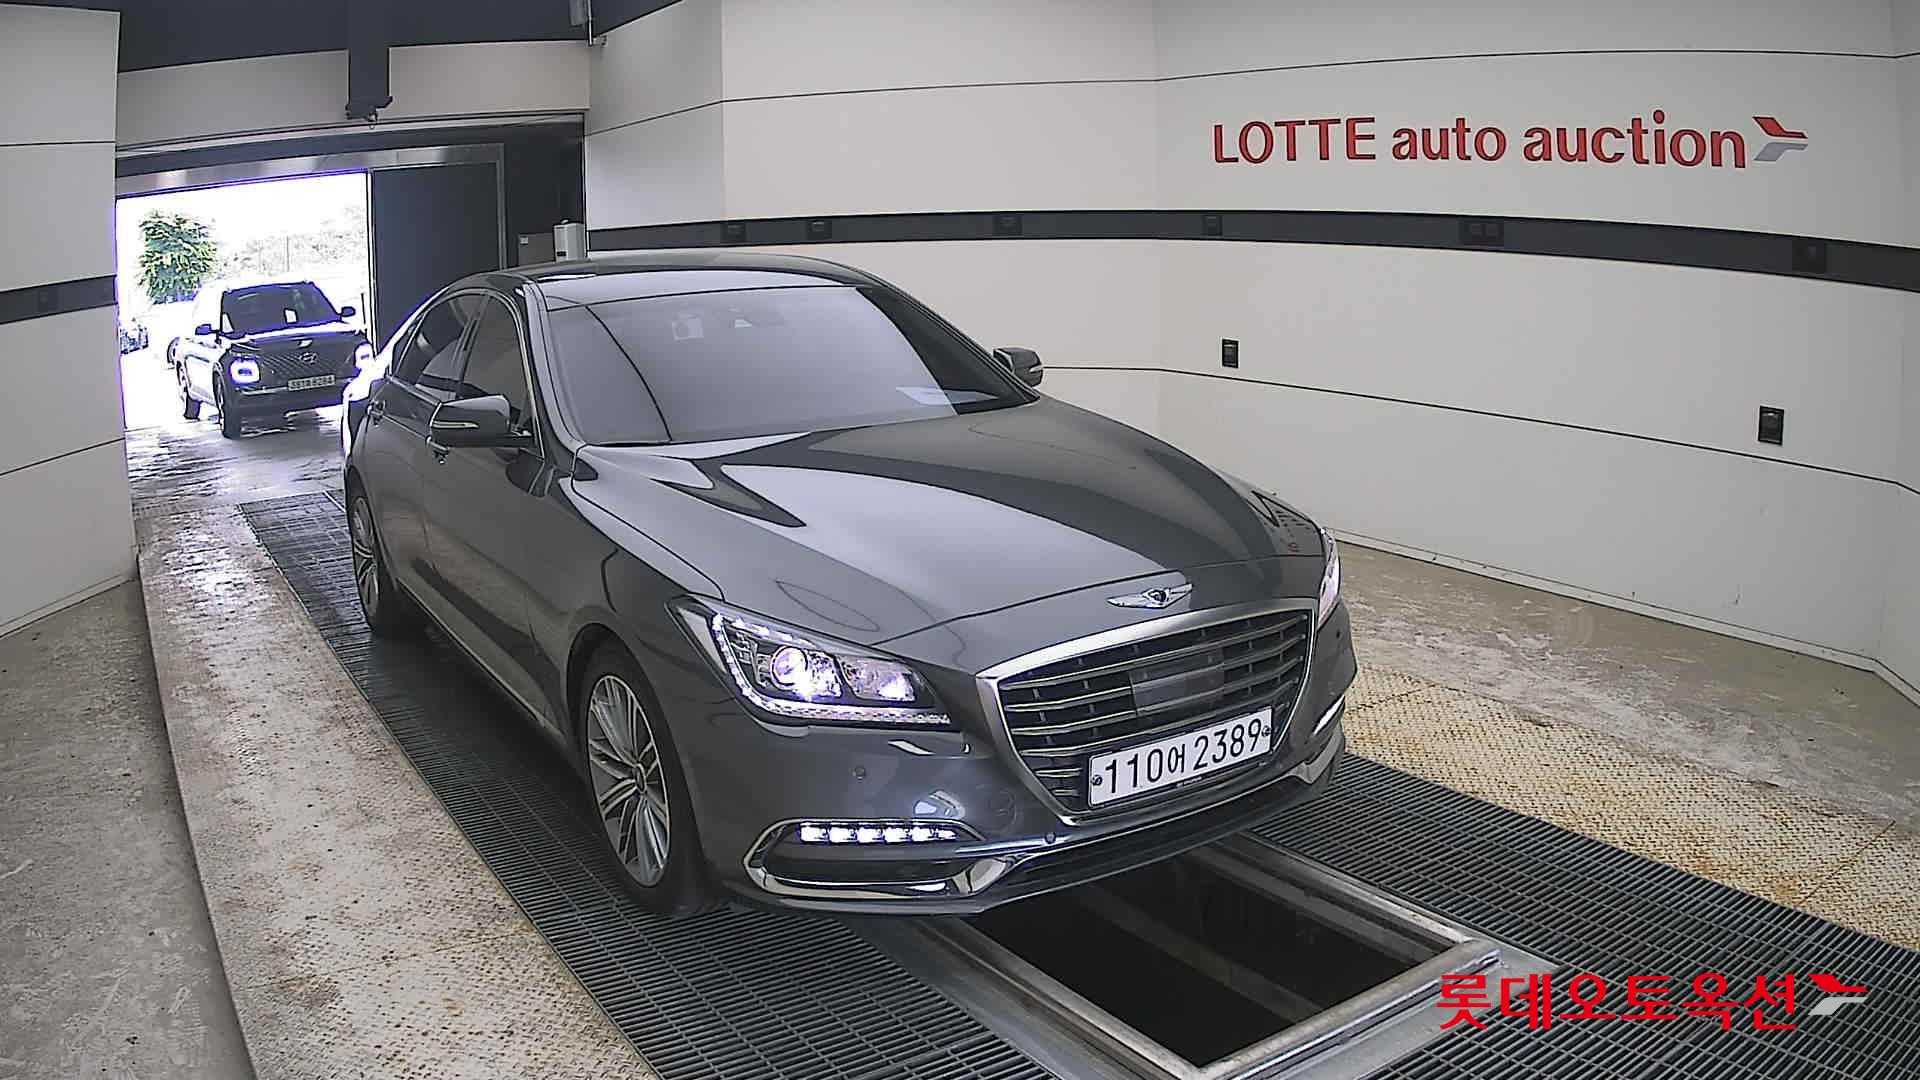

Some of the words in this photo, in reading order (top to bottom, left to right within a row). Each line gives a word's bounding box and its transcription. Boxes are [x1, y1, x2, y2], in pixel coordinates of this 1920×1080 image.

[1213, 116, 1376, 164] LOTTE
[1391, 117, 1507, 161] auto
[1522, 109, 1746, 168] auction
[1105, 743, 1186, 794] 110어
[1193, 718, 1262, 771] 2389
